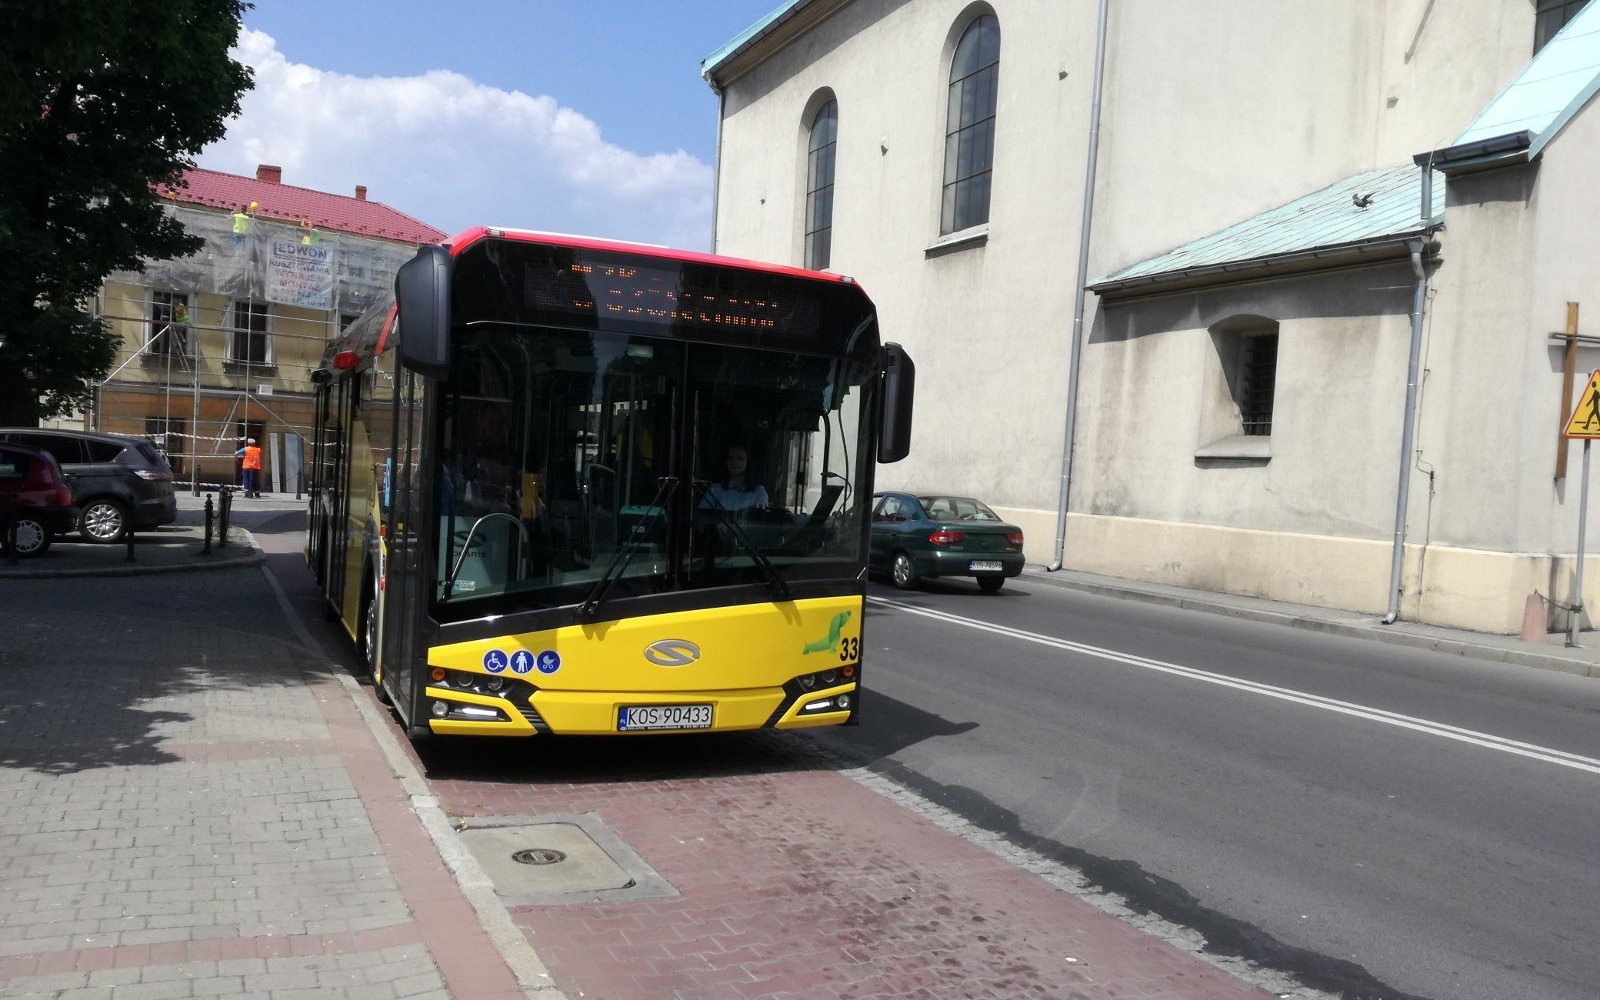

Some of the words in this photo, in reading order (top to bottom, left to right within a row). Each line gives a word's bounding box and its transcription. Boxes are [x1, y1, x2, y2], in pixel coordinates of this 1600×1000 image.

[840, 636, 859, 661] 33
[628, 707, 658, 726] KOS
[663, 706, 710, 724] 90433
